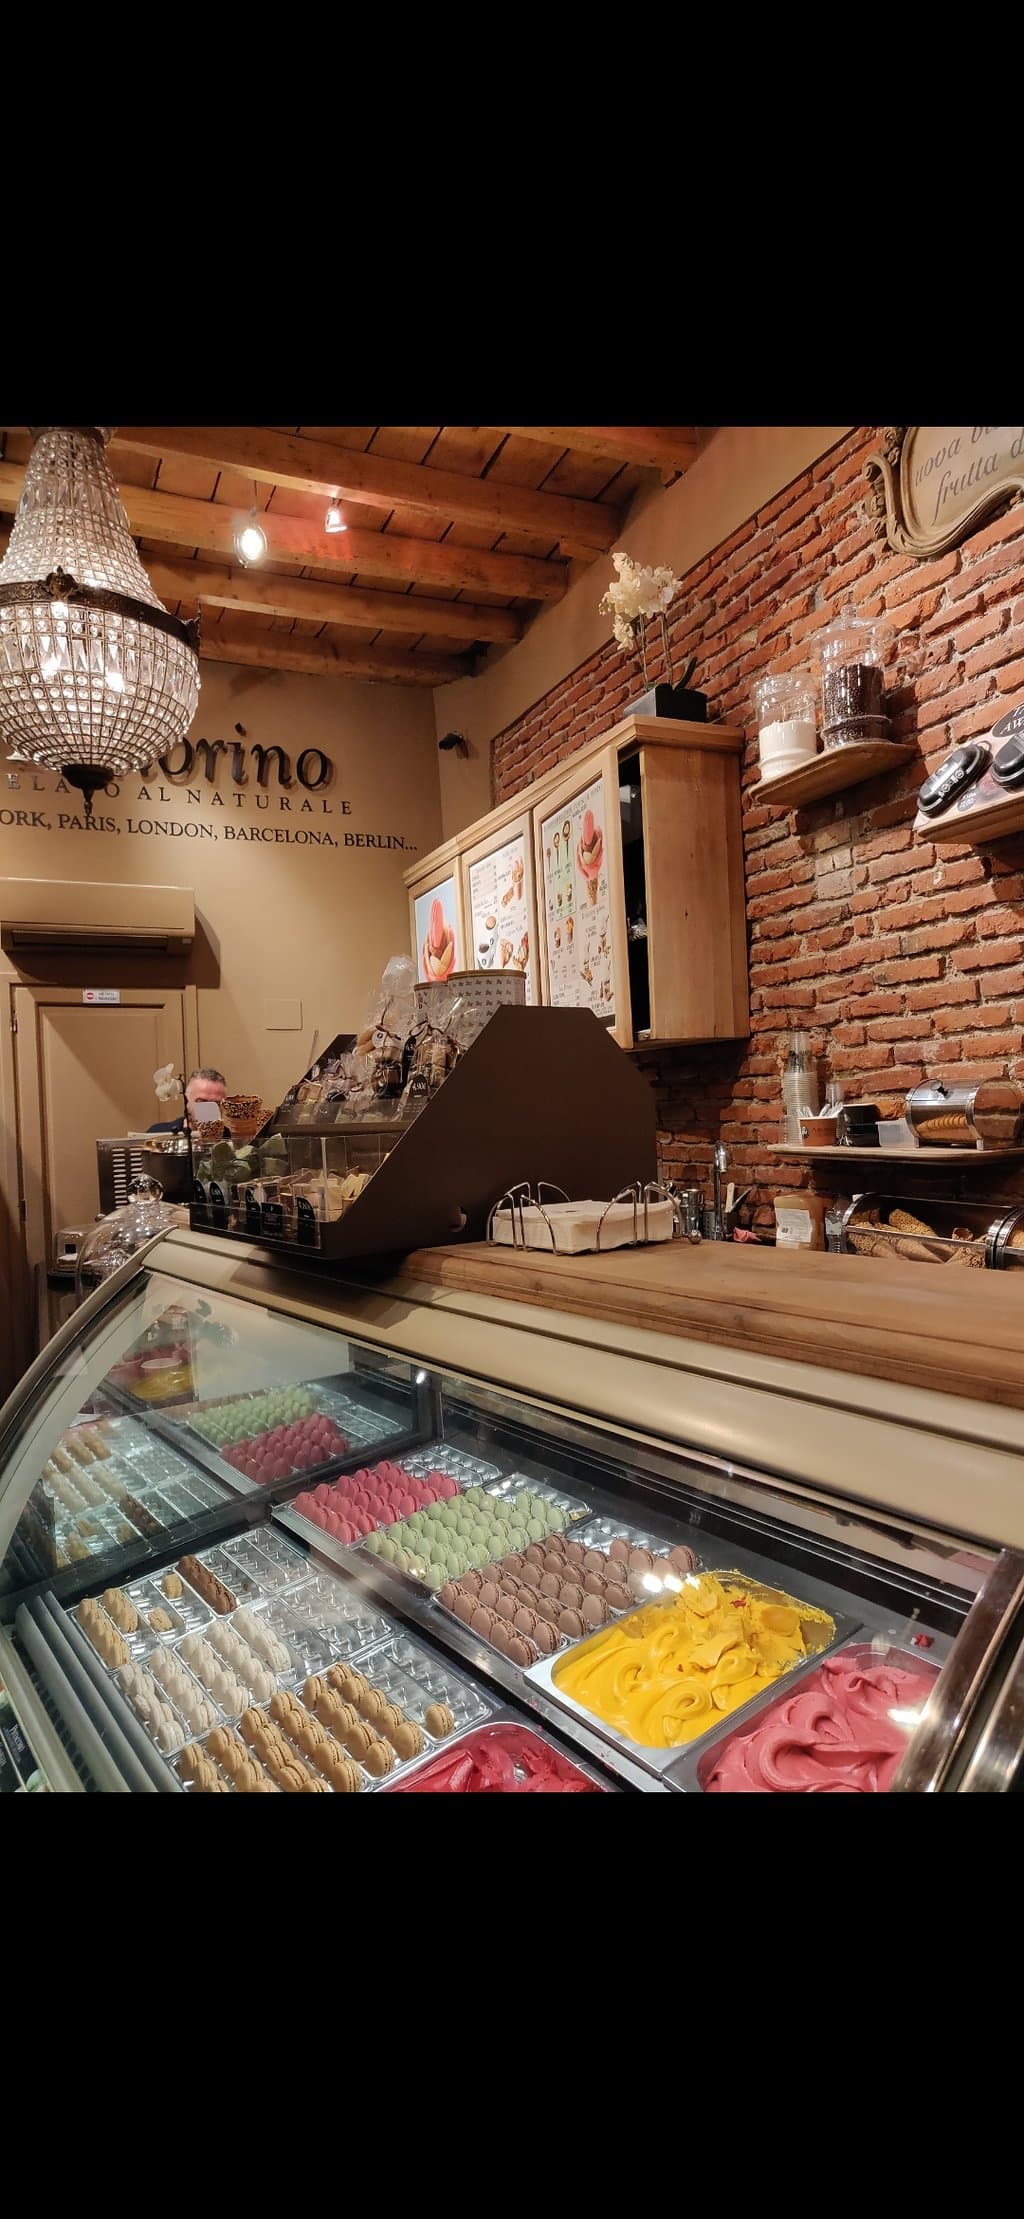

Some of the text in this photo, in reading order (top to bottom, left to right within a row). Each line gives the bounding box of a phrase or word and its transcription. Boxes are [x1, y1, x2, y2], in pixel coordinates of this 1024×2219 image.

[141, 722, 328, 791] orino
[8, 773, 352, 815] ELAO AL NATURALE
[58, 813, 120, 835] PARIS,
[128, 819, 219, 841] LONDON,
[224, 825, 338, 848] BARCELONA,
[344, 833, 418, 851] BERLIN...
